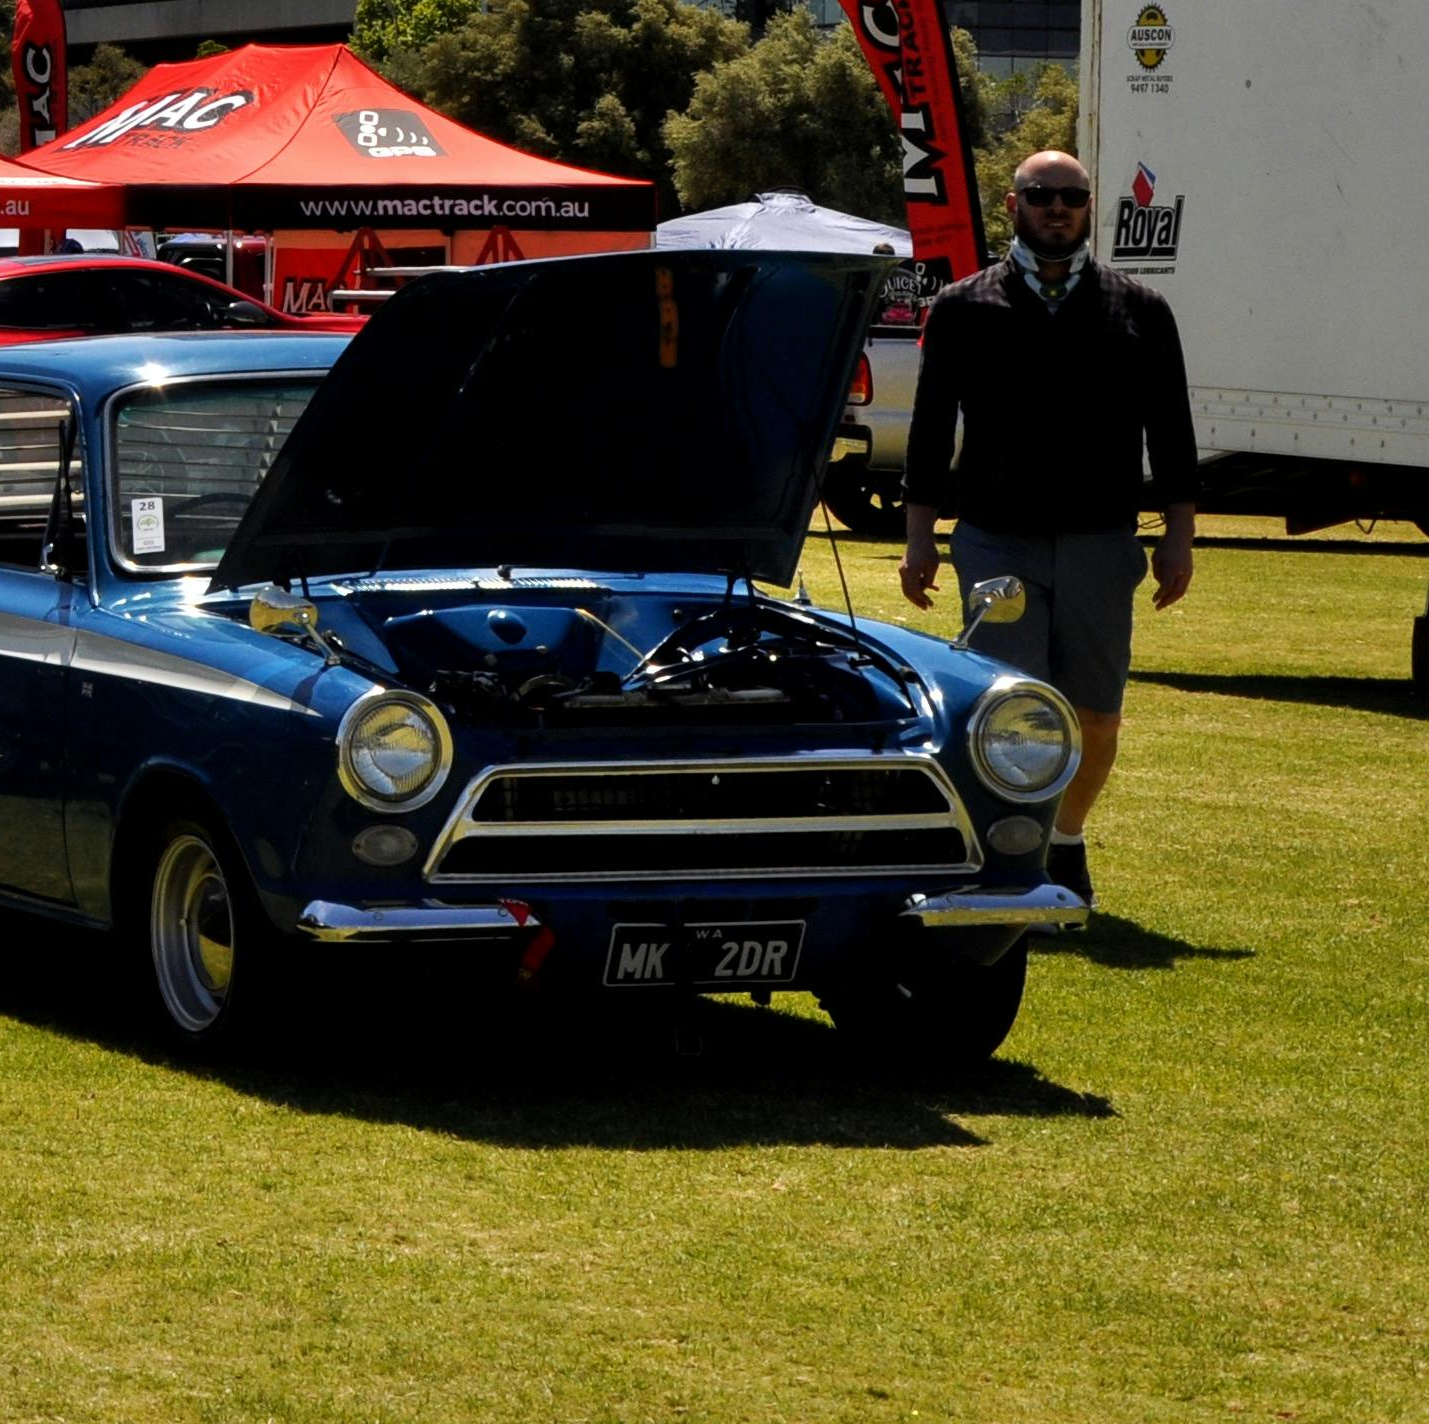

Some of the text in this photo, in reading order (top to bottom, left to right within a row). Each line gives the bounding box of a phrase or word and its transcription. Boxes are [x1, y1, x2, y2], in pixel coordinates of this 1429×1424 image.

[1131, 29, 1171, 41] AUSCON
[62, 92, 247, 150] MAC
[369, 146, 436, 158] GPS
[300, 194, 589, 218] www.mactrack.com.au
[1114, 197, 1184, 257] Royal
[283, 281, 332, 314] MA
[139, 500, 156, 512] 28
[616, 940, 789, 980] MK 2DR
